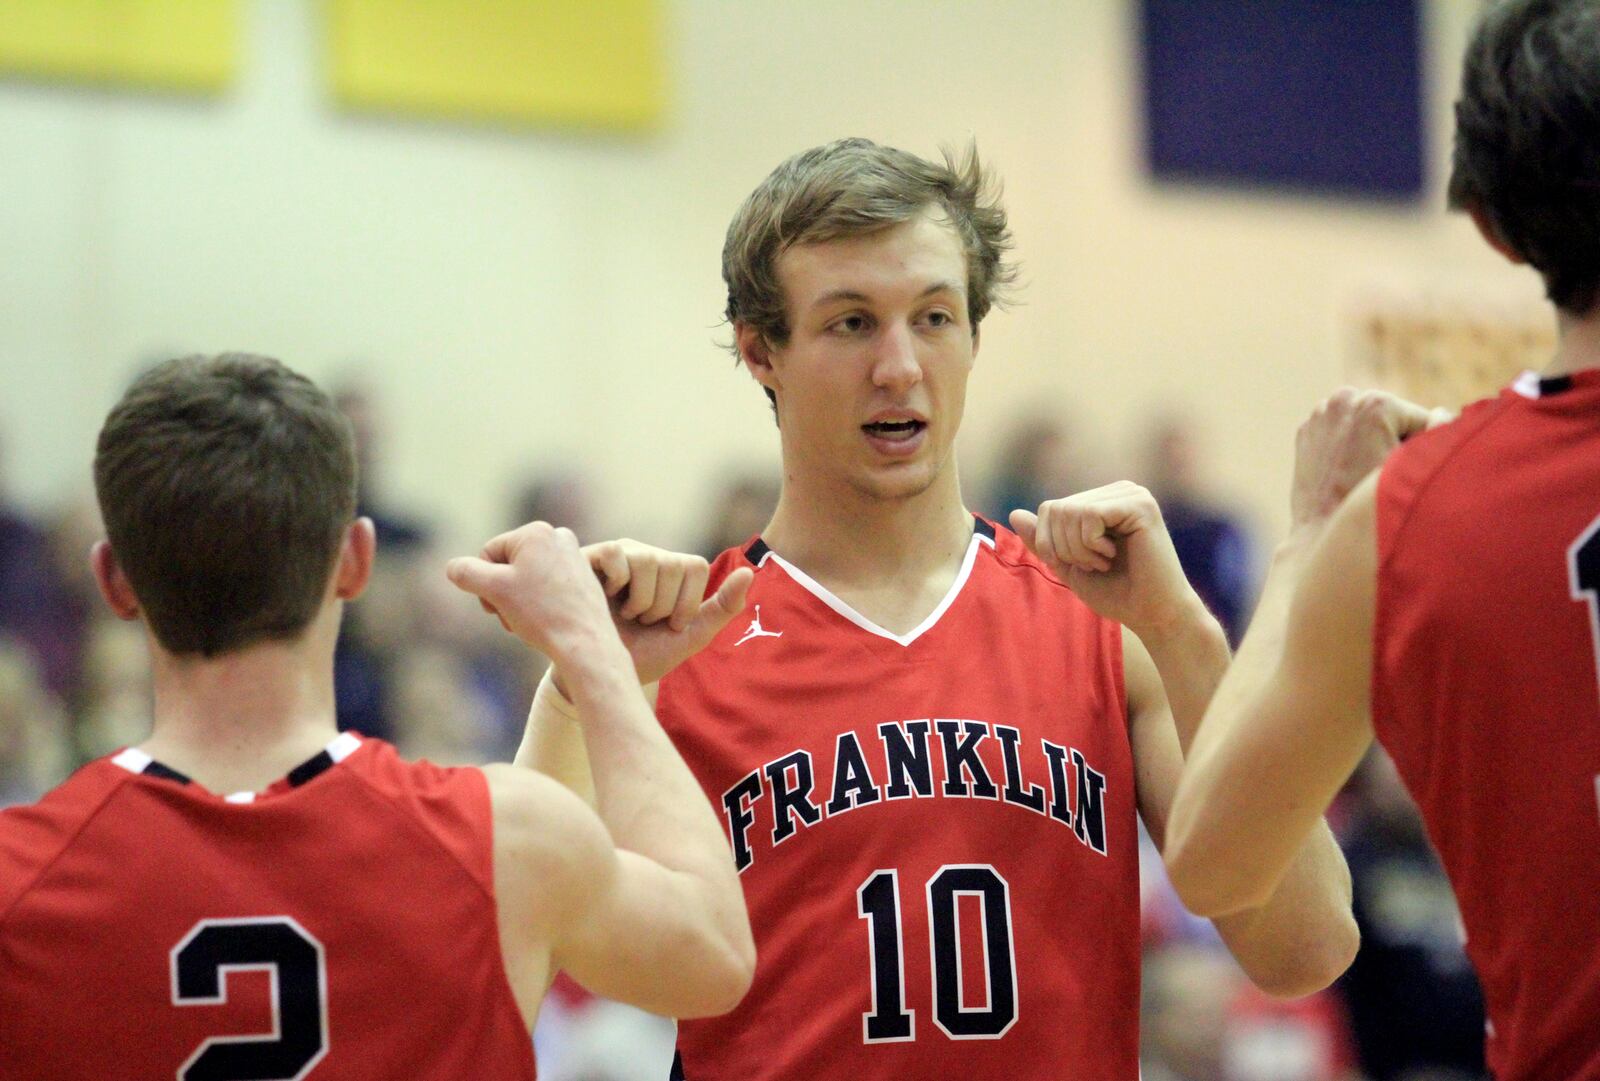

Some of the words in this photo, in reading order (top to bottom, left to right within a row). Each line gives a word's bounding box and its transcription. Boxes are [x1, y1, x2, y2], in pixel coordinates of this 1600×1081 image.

[721, 719, 1108, 874] FRANKLIN
[170, 915, 330, 1081] 2
[857, 863, 1019, 1044] 10
